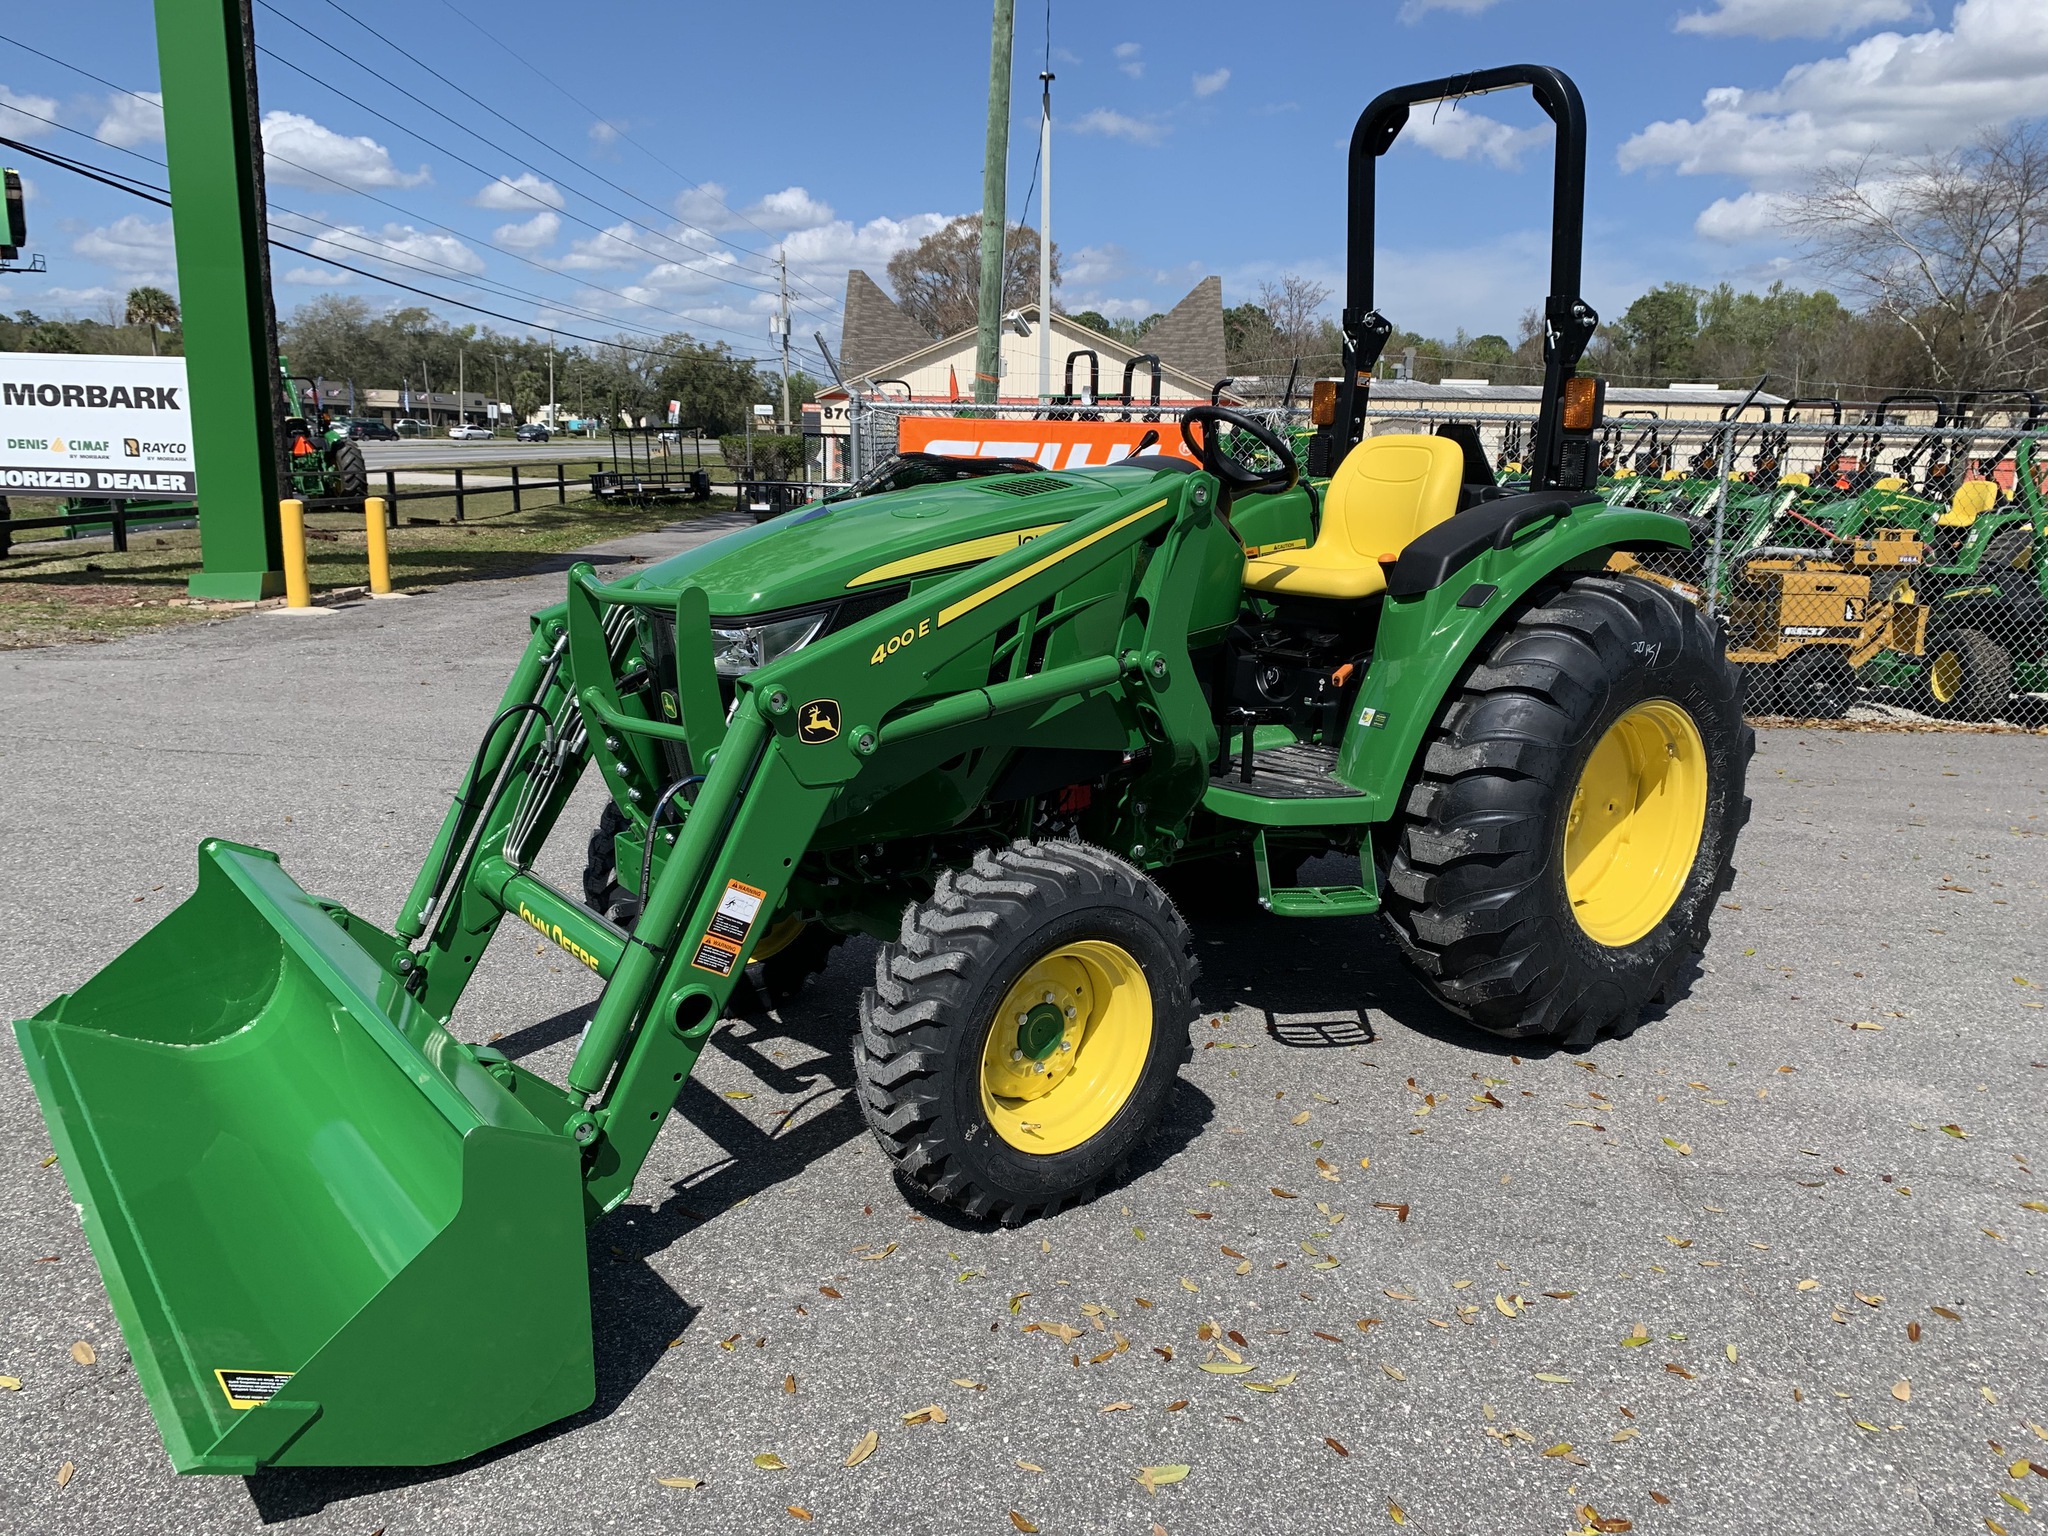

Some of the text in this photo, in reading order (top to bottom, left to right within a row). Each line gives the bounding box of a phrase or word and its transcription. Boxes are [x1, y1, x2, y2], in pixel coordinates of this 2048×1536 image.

[3, 383, 181, 410] MORBARK
[7, 438, 109, 451] DENIS CIMAF
[142, 442, 186, 454] RAYCO
[97, 473, 187, 491] DEALER
[870, 618, 931, 667] 400 E
[1683, 682, 1728, 769] TITAN
[739, 884, 761, 897] WARNING
[713, 940, 737, 952] WARNING
